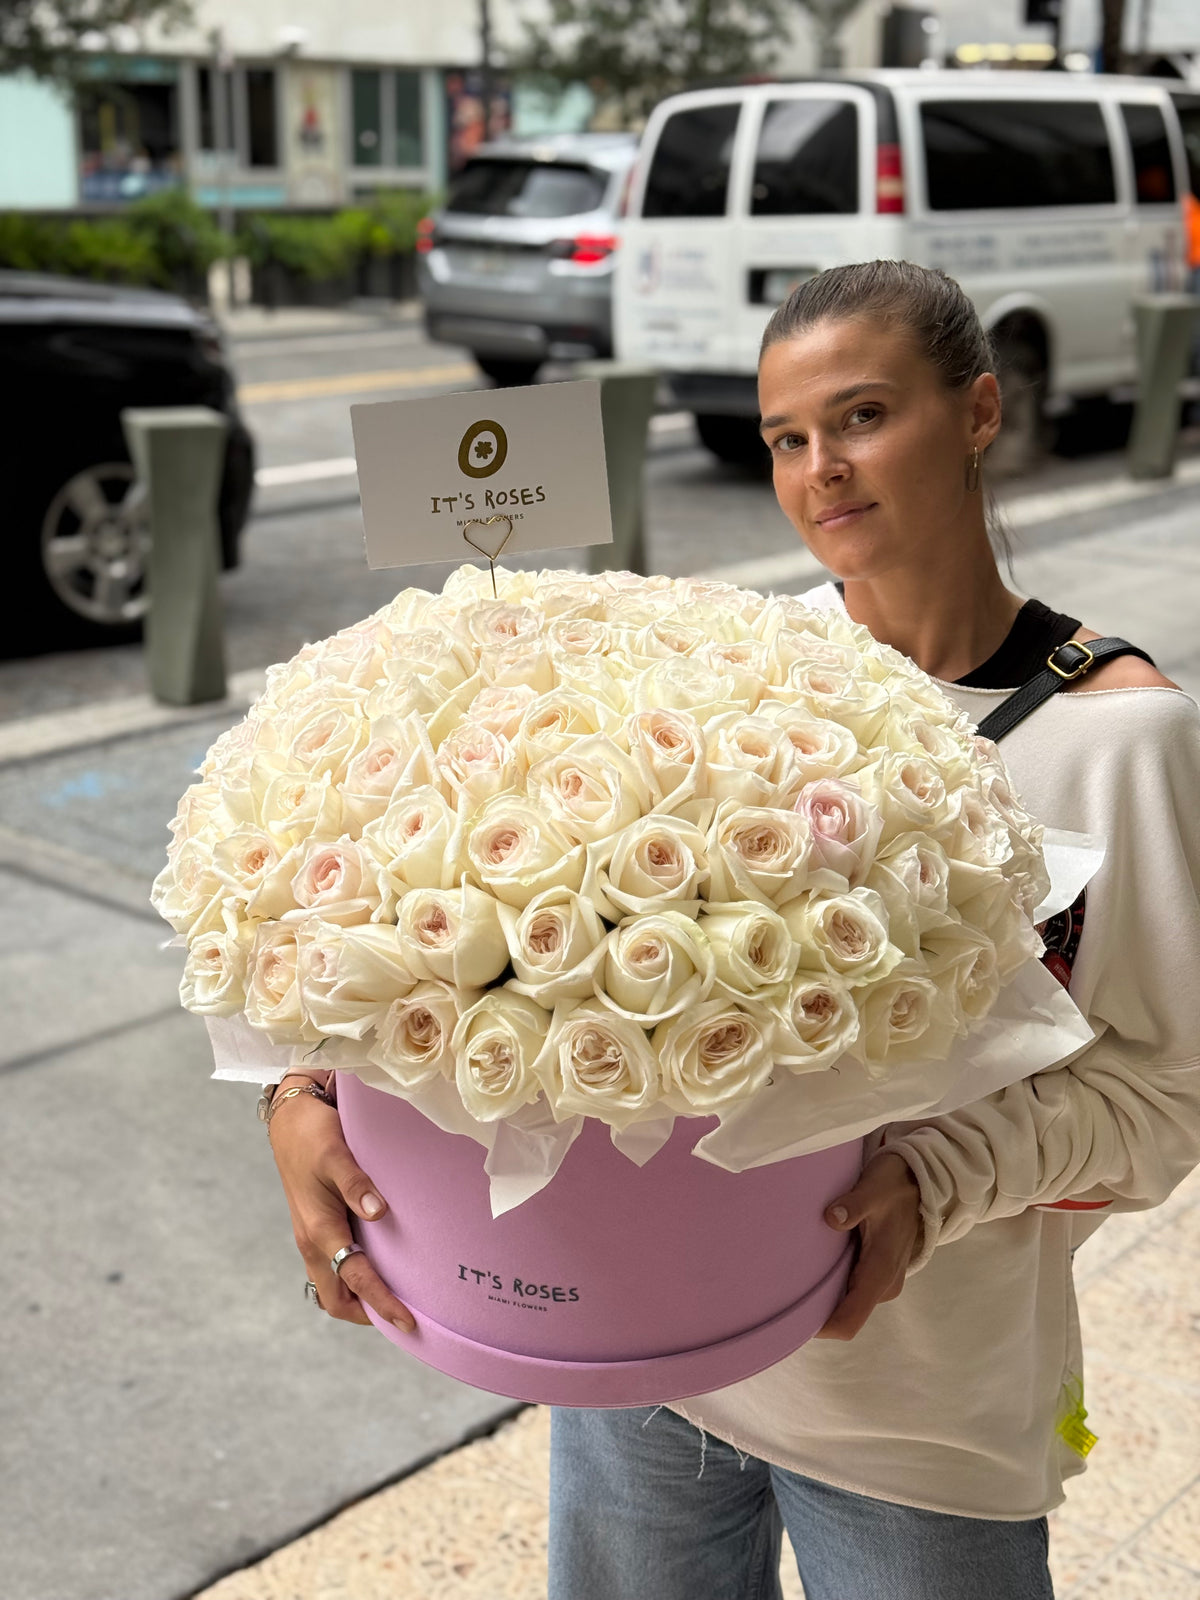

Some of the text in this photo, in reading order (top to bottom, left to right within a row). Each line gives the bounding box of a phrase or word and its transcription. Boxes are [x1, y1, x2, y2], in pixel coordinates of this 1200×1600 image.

[431, 486, 545, 513] IT'S ROSES
[458, 1264, 579, 1302] IT'S ROSES
[488, 1295, 547, 1312] MIAMI FLOWERS
